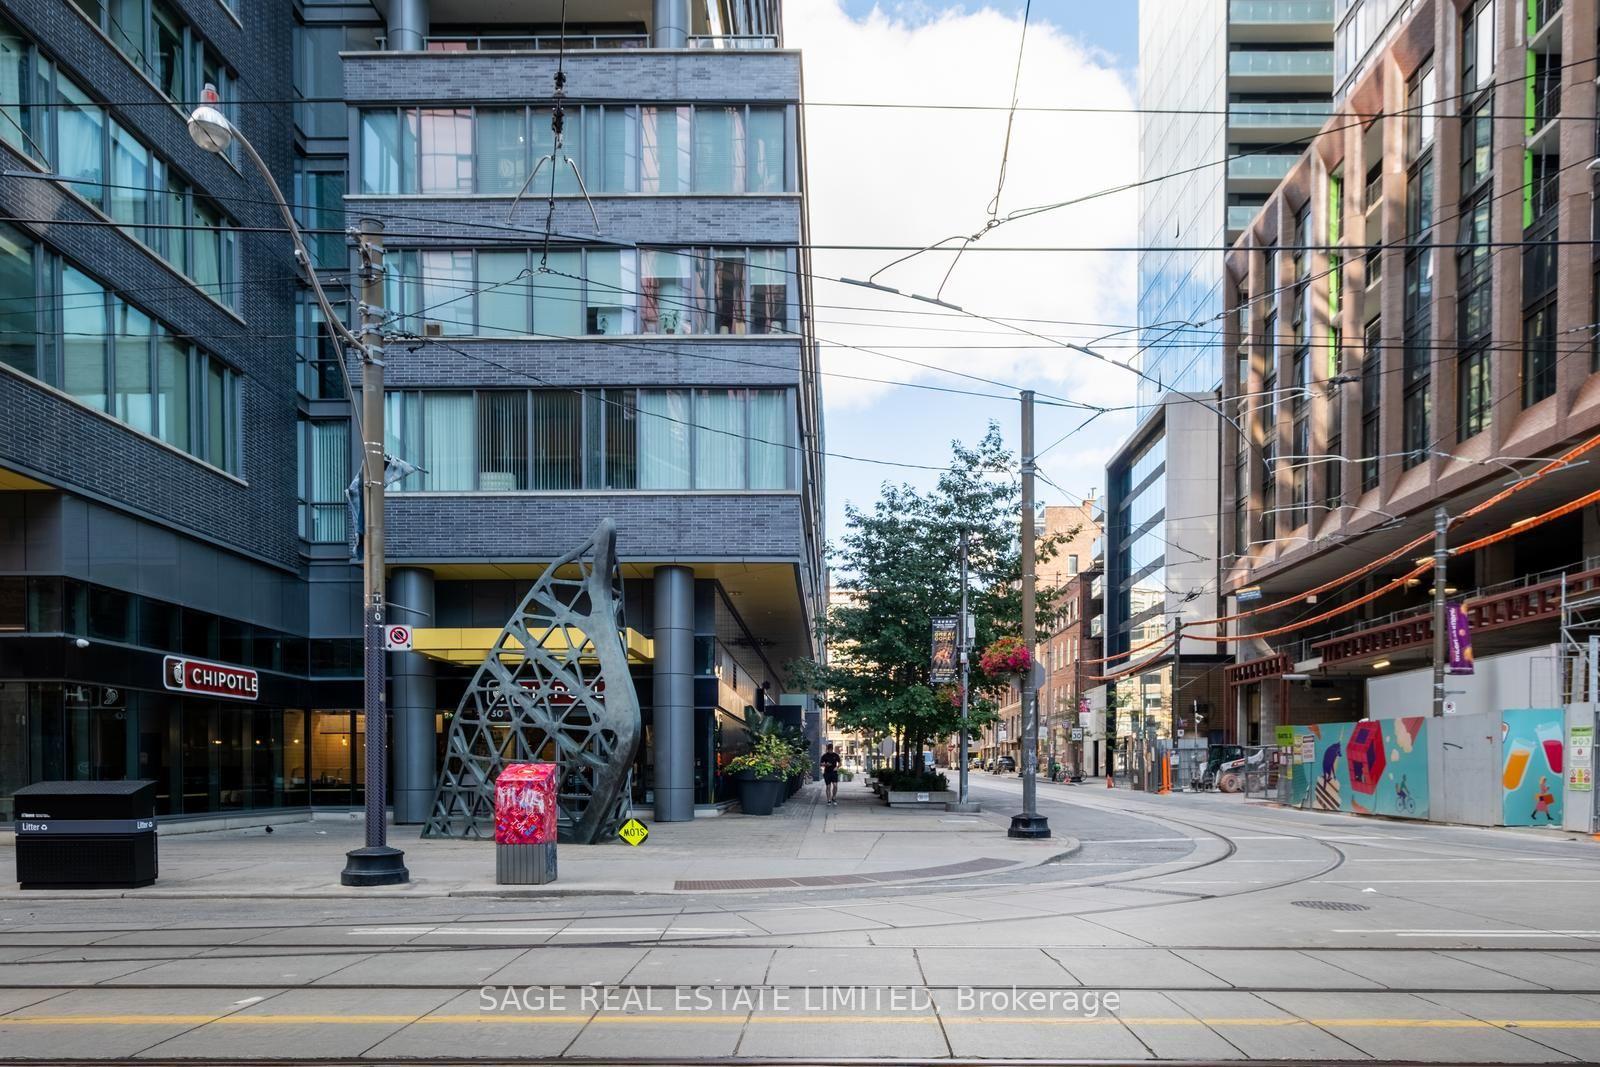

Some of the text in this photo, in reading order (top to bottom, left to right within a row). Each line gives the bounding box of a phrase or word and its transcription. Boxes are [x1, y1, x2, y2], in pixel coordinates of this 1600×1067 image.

[192, 668, 259, 692] CHIPOTLE
[22, 822, 40, 831] Litter
[623, 828, 645, 837] SLOW
